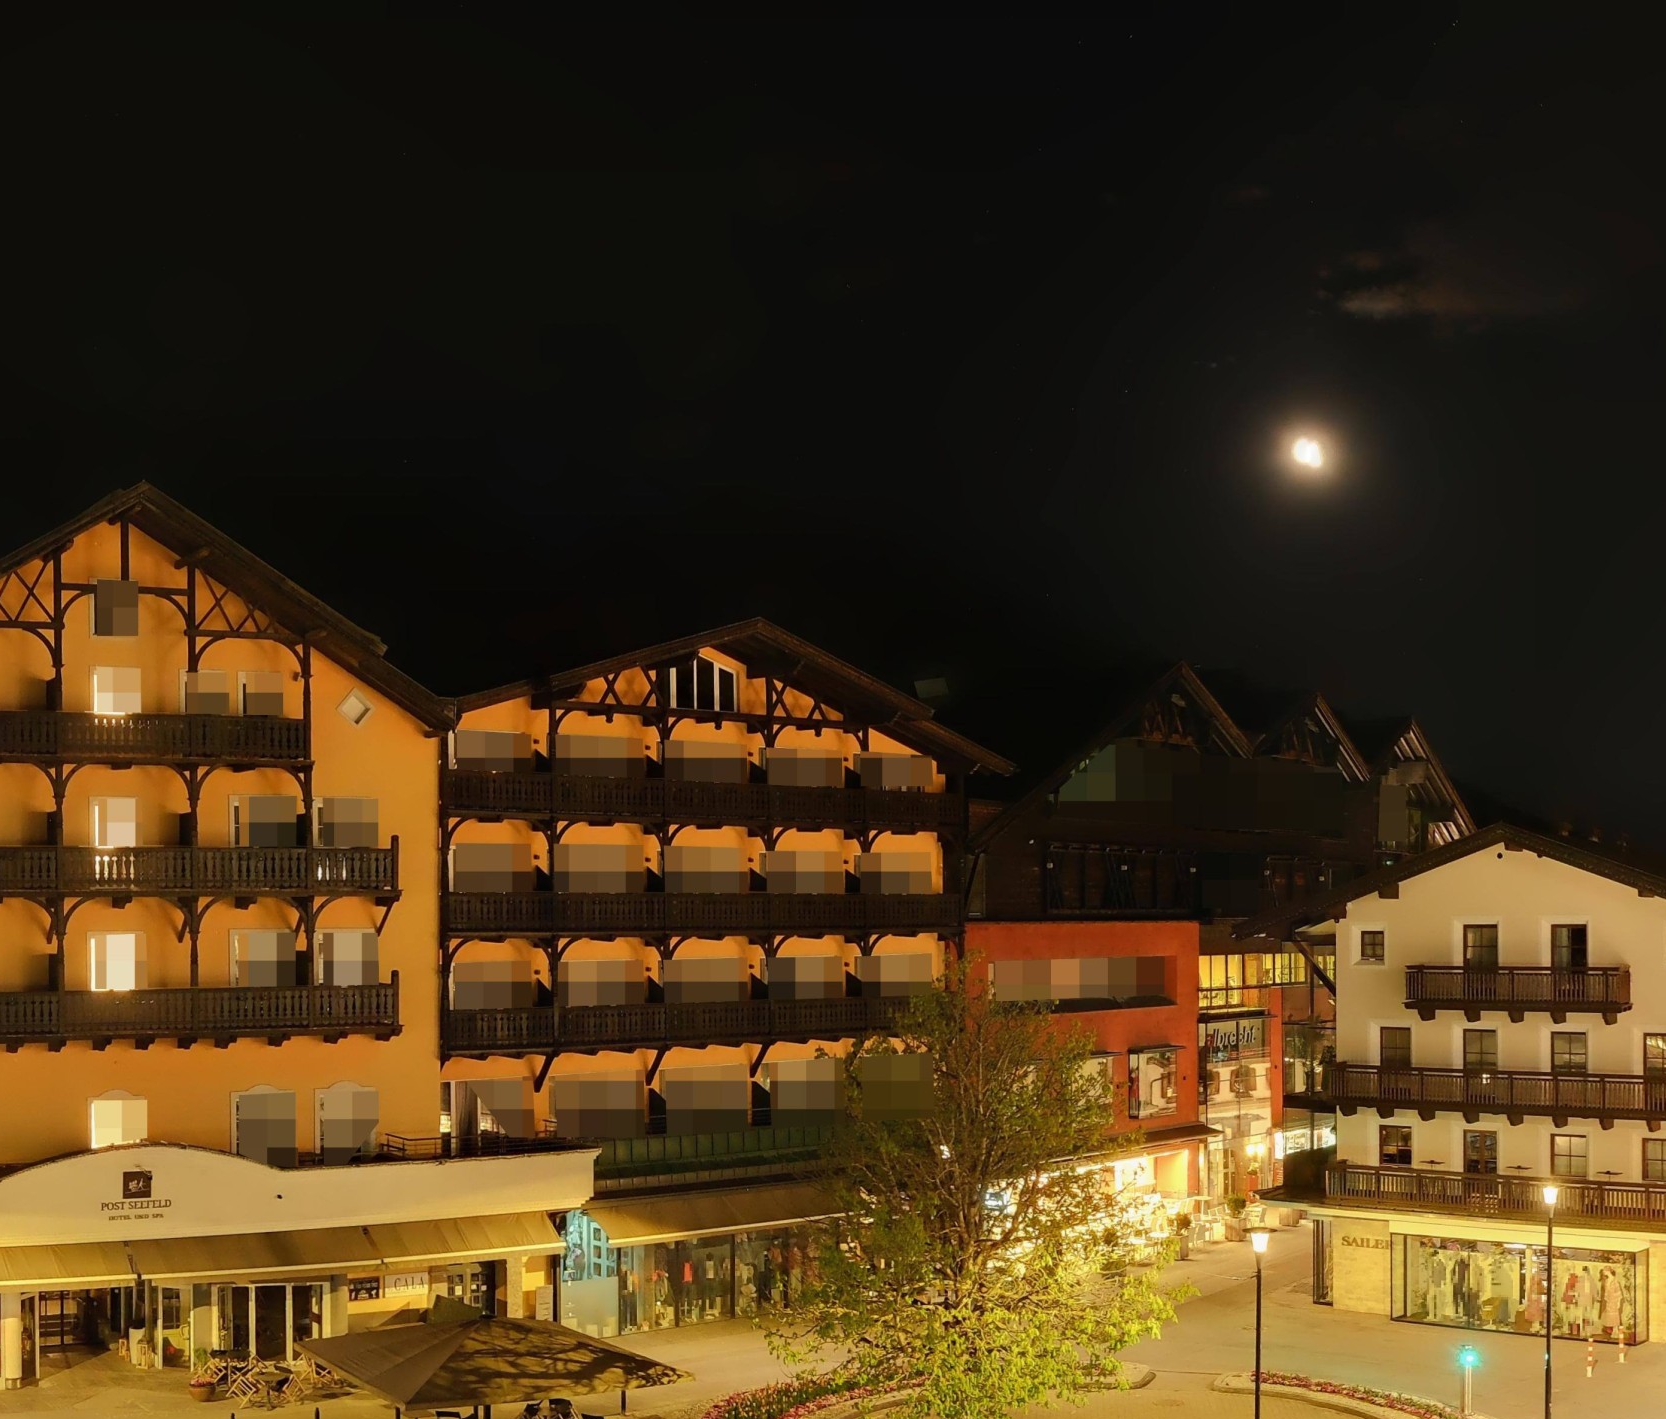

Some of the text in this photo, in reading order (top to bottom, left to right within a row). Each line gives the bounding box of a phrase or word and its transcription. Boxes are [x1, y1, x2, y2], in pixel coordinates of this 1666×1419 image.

[101, 1199, 172, 1211] POST SEEFELD
[394, 1276, 425, 1291] CALA
